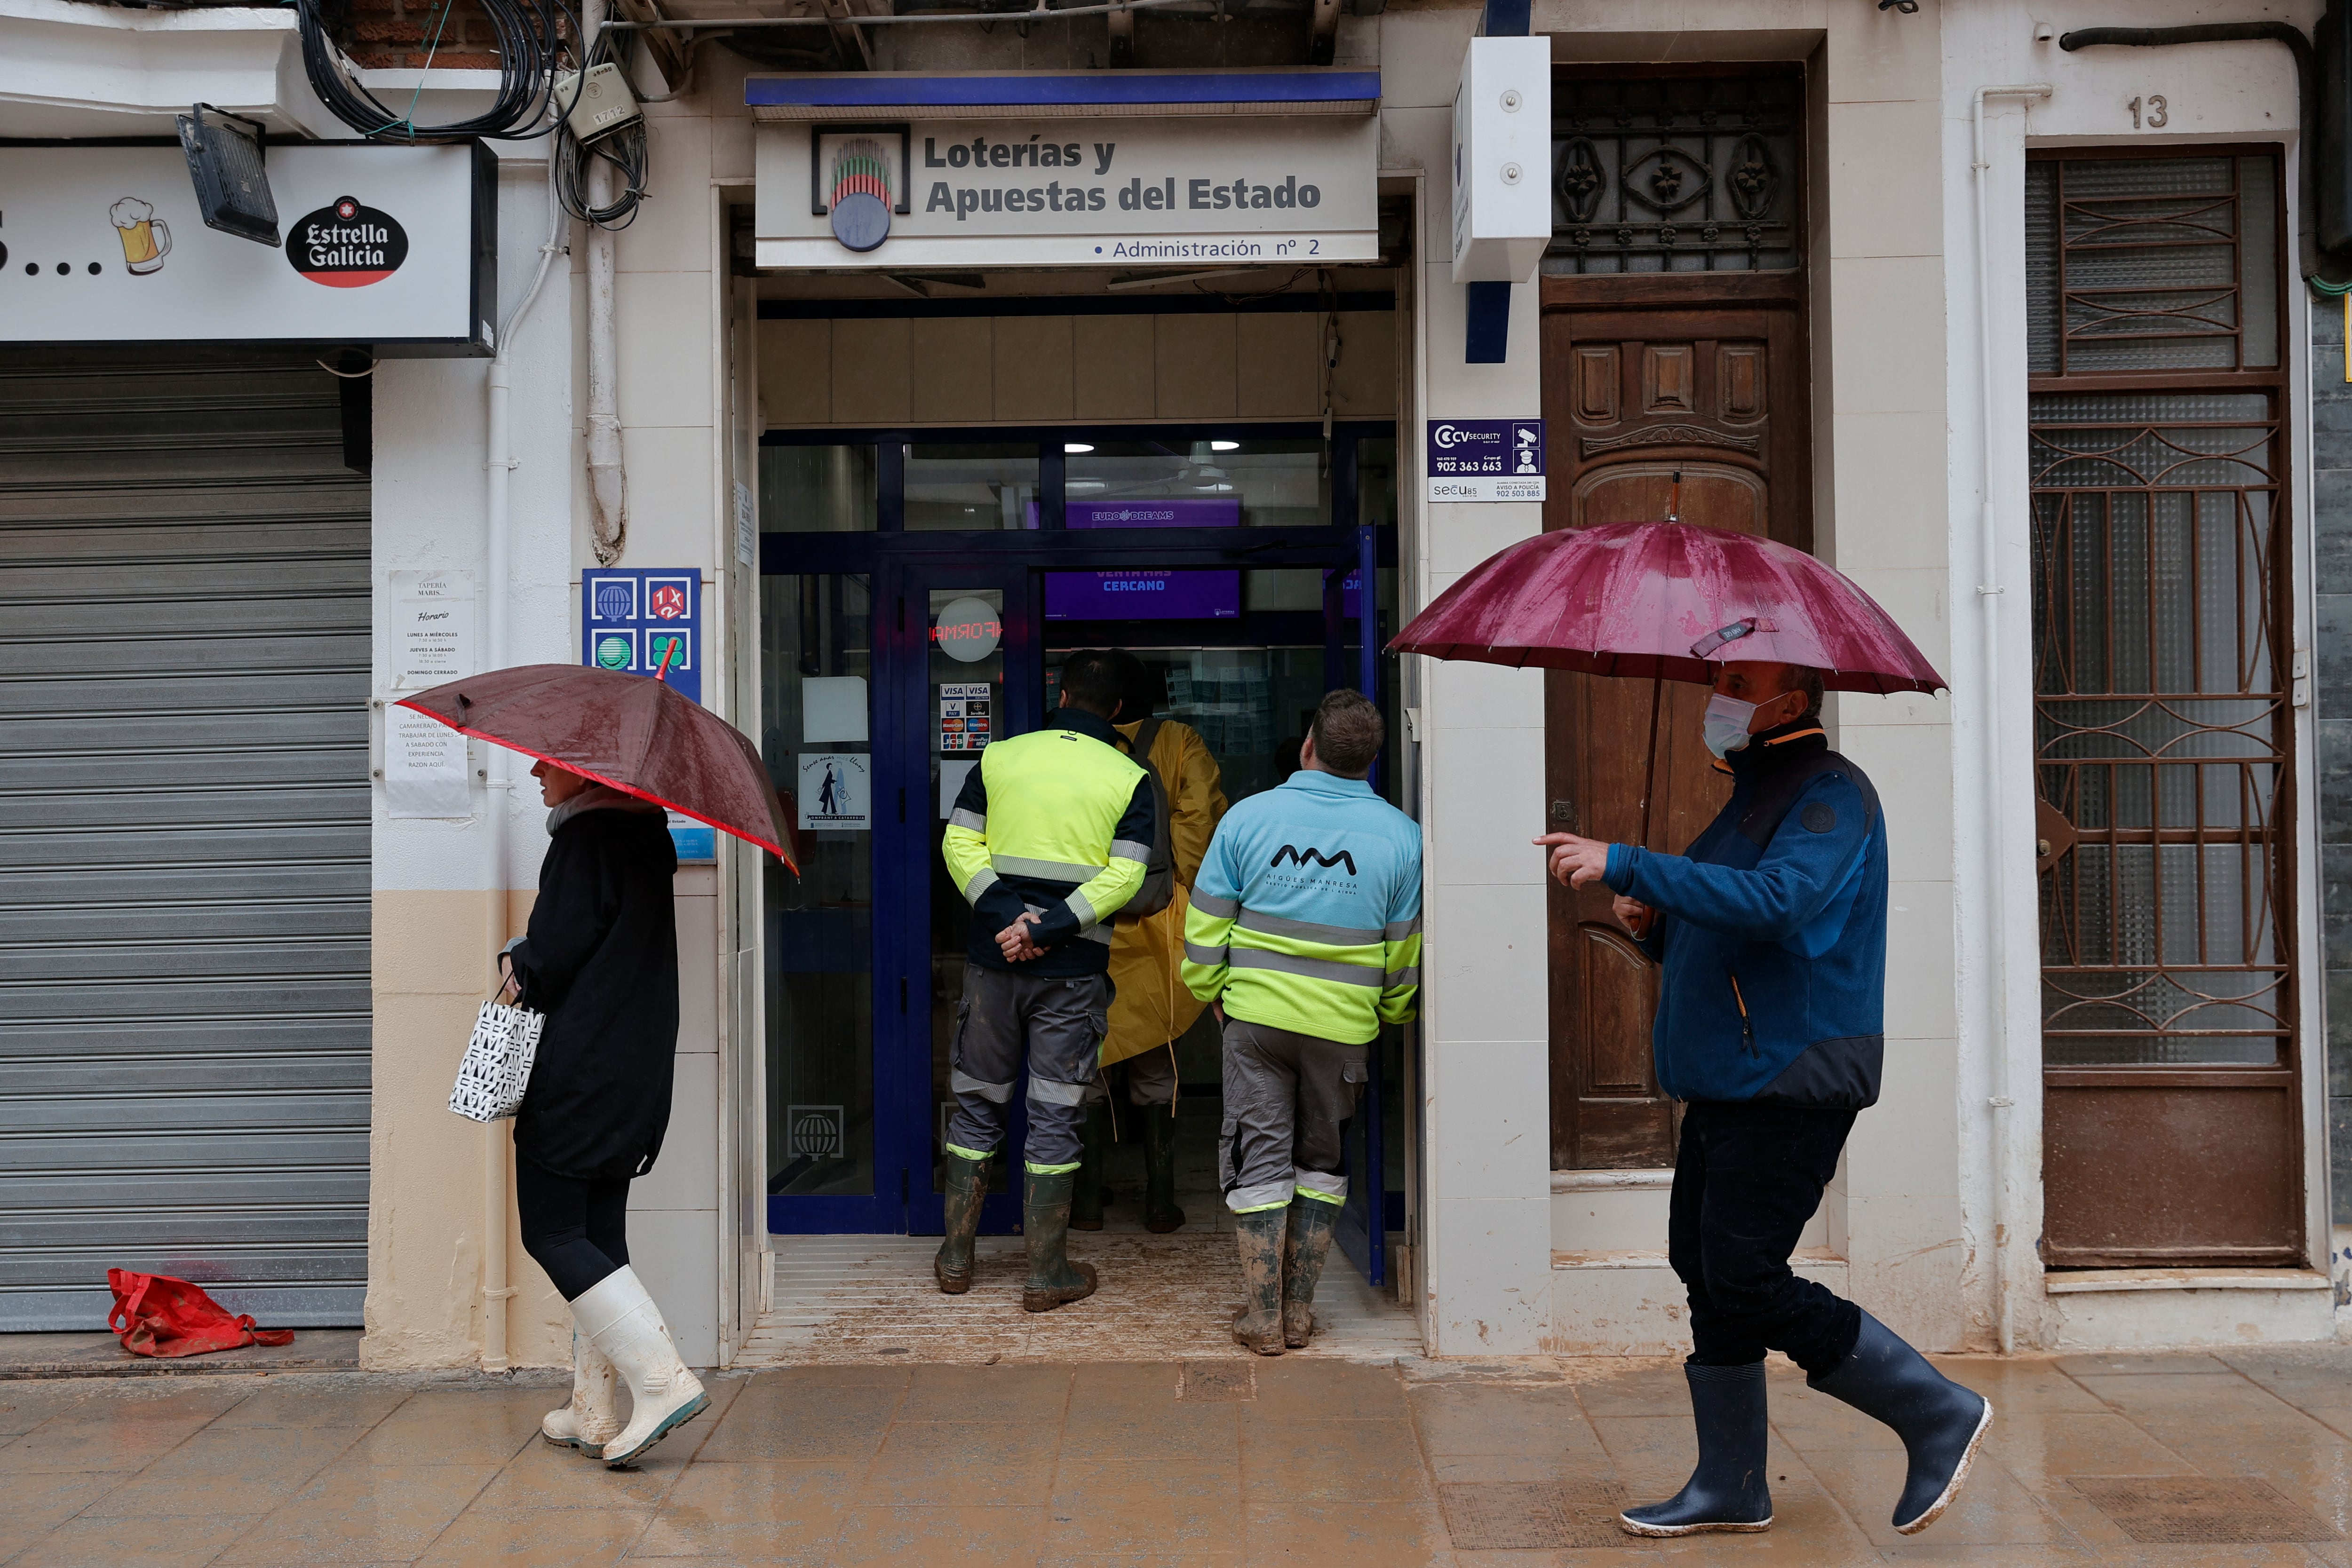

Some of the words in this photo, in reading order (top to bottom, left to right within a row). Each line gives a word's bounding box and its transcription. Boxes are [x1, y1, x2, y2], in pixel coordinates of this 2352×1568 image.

[595, 106, 625, 124] 1712
[2129, 95, 2168, 128] 13
[925, 135, 1081, 168] Loterías
[1095, 143, 1115, 175] y
[926, 182, 1106, 221] Apuestas
[1119, 177, 1175, 210] del
[1189, 176, 1321, 210] Estado
[306, 223, 389, 245] Estrella
[309, 245, 384, 266] Galicia
[1113, 240, 1261, 257] Administración
[1276, 240, 1296, 256] nº
[1309, 240, 1320, 255] 2
[1437, 462, 1456, 471] 902
[1460, 462, 1479, 471] 363
[1482, 462, 1502, 471] 663
[1104, 580, 1165, 591] CERCANO
[656, 592, 664, 604] 1
[671, 590, 681, 607] X
[418, 611, 449, 622] Horario
[1310, 879, 1358, 889] MANRESA
